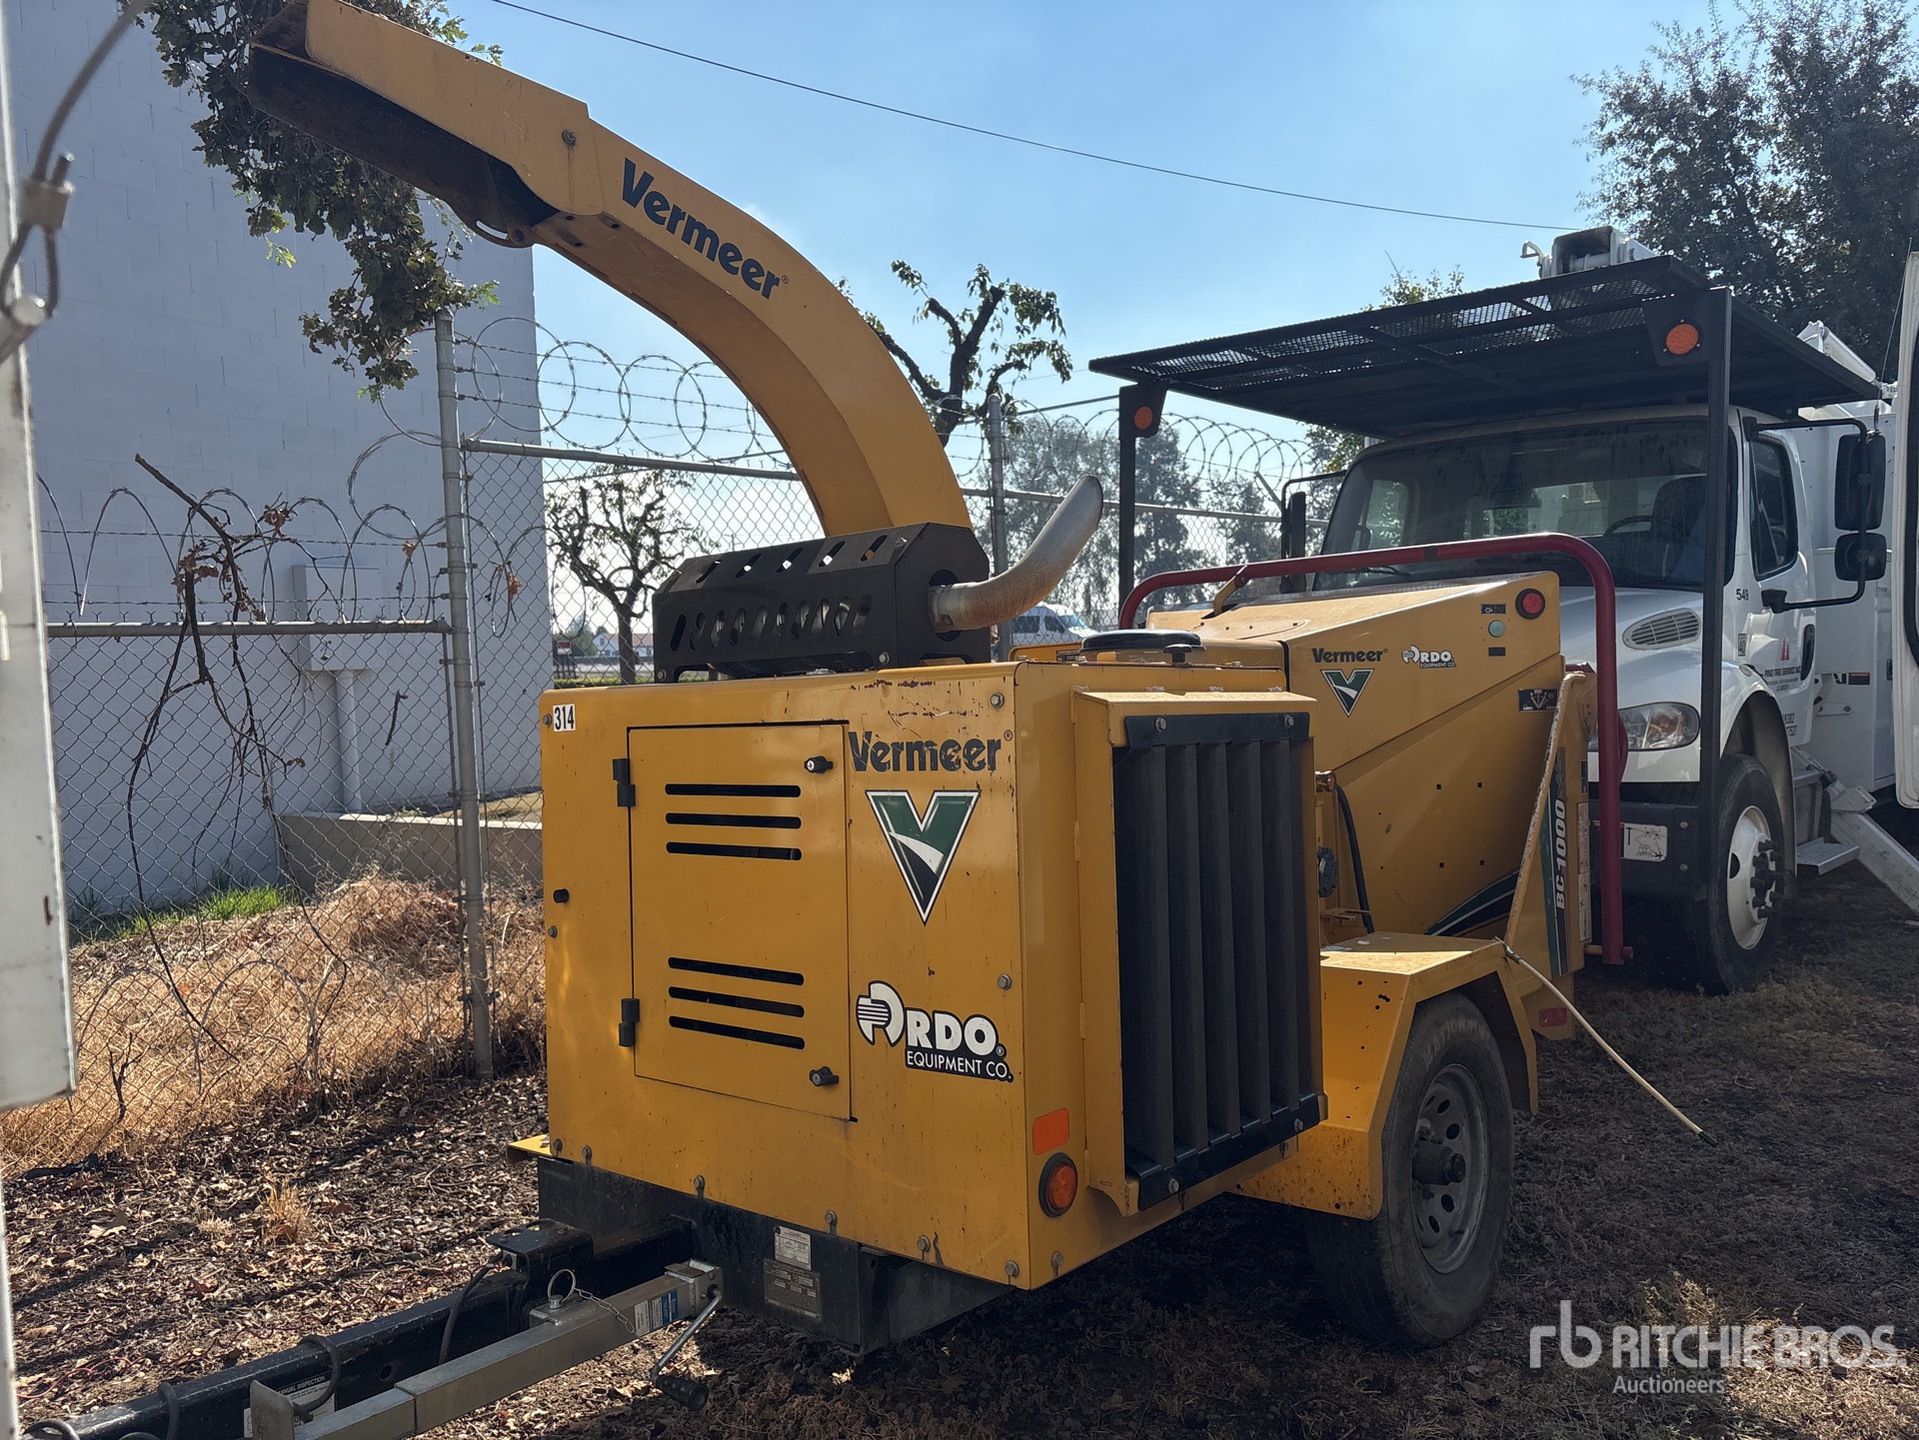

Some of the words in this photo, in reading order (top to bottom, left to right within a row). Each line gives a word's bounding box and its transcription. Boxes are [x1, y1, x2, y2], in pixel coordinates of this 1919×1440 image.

[622, 157, 780, 300] Vermeer
[1736, 588, 1749, 601] 549
[1311, 648, 1383, 663] Vermeer
[554, 705, 575, 730] 314
[848, 731, 1002, 772] Vermeer
[907, 1050, 983, 1075] EQUIPMENT
[985, 1061, 1012, 1079] CO.
